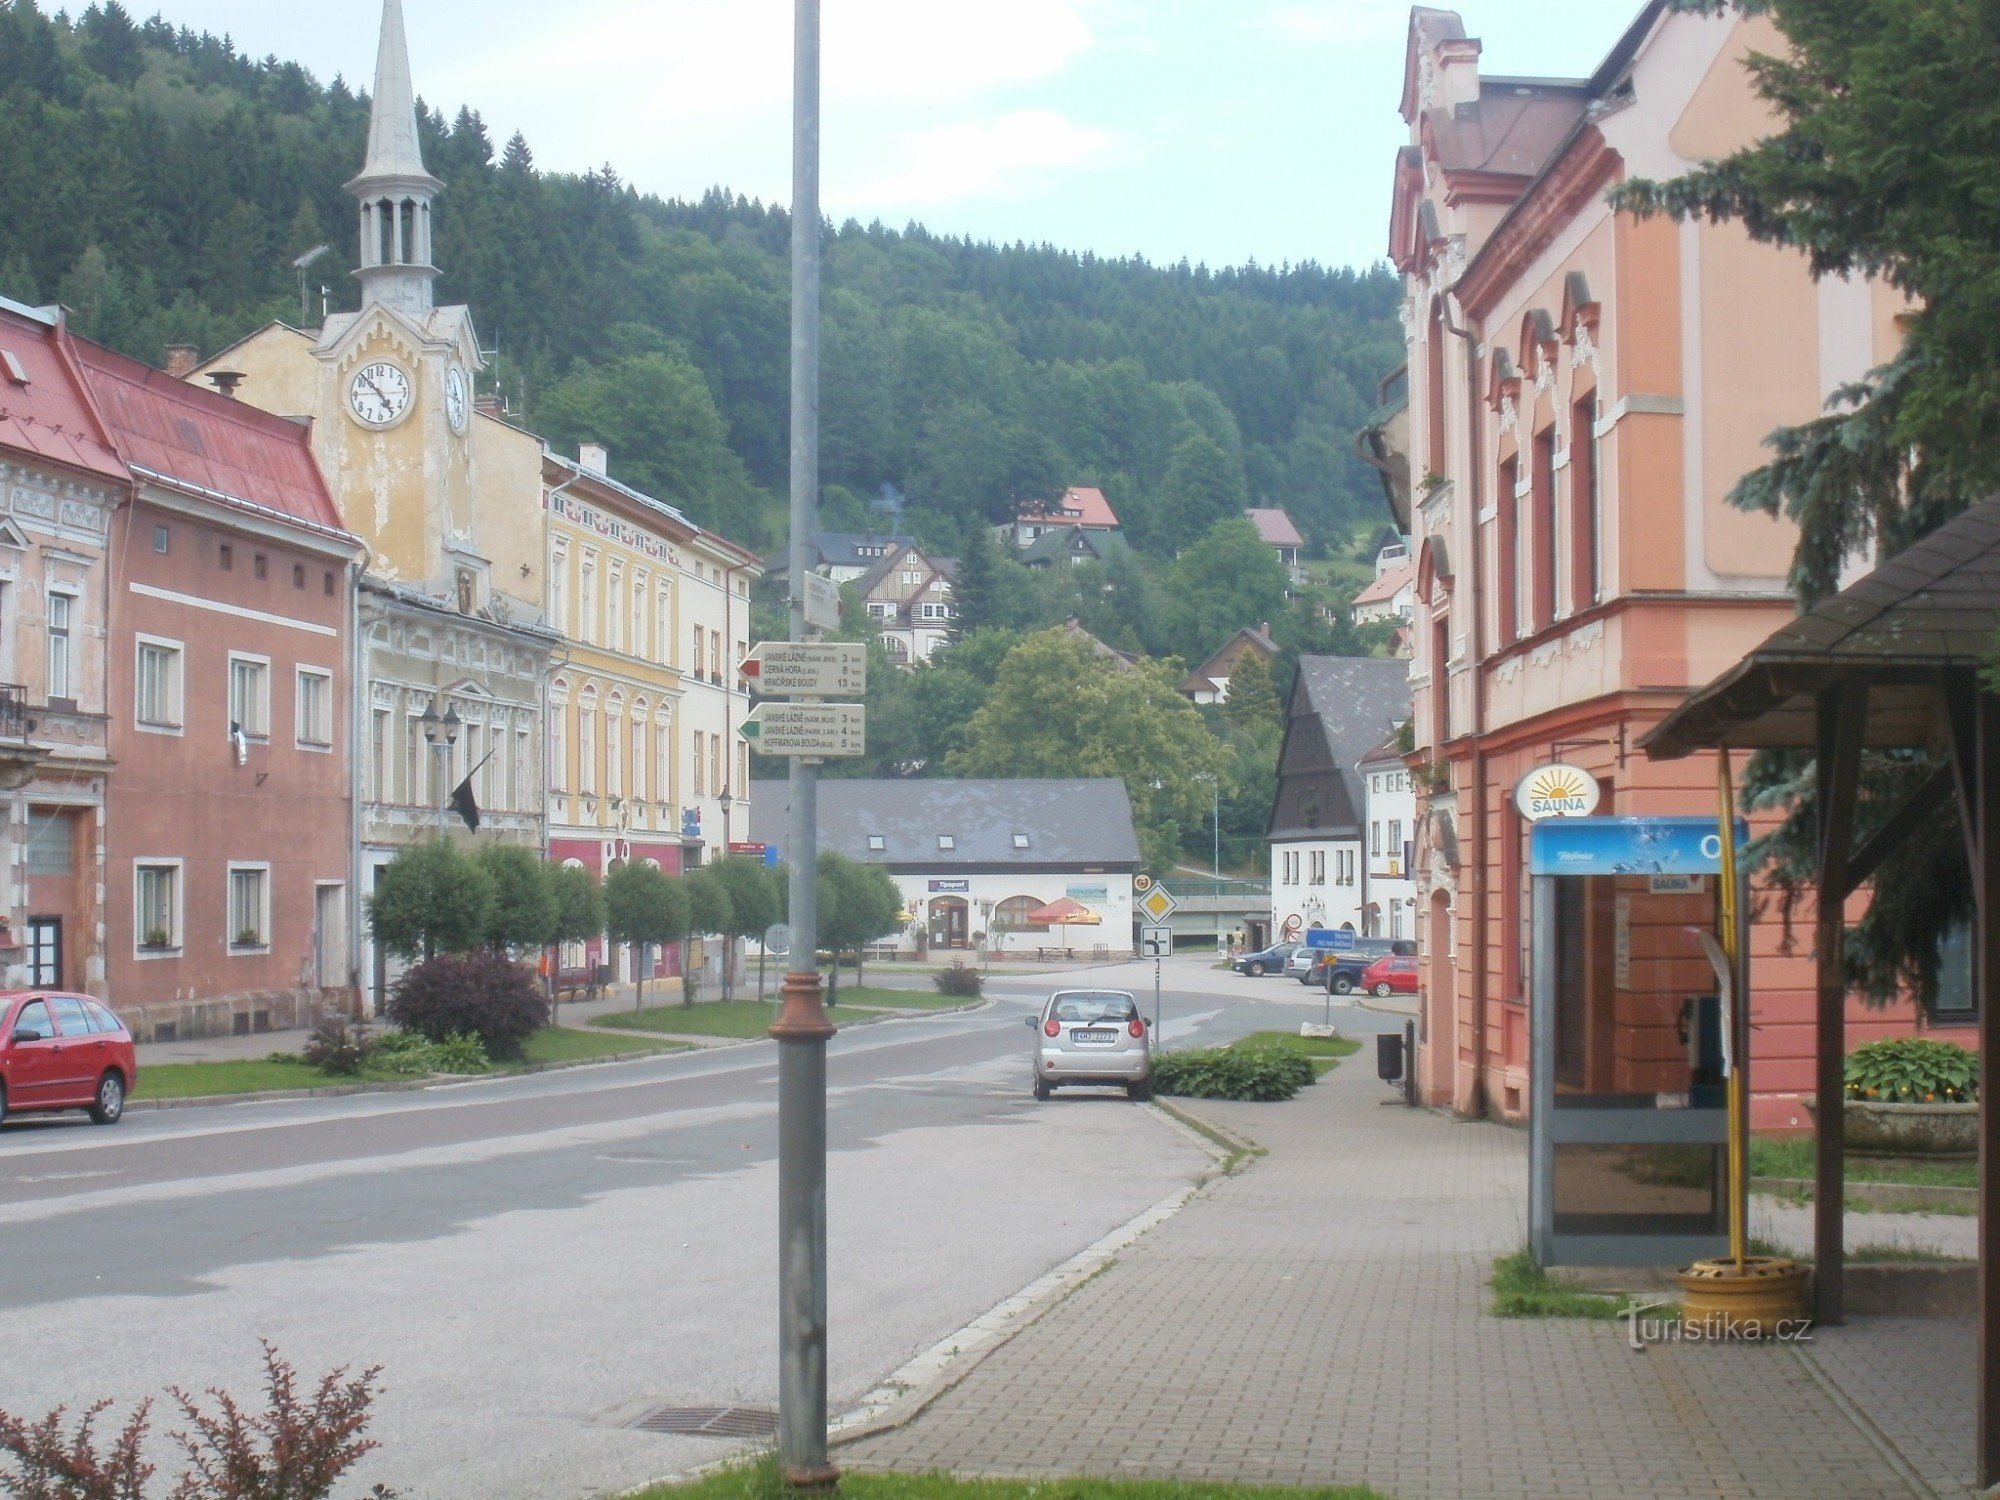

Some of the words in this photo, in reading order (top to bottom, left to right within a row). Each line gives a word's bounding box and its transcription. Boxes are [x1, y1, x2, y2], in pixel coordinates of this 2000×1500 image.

[367, 368, 374, 380] 11
[376, 365, 384, 376] 12
[390, 368, 393, 378] 1
[358, 377, 366, 388] 10
[397, 374, 403, 386] 2
[353, 390, 358, 401] 9
[402, 387, 407, 398] 3
[358, 400, 364, 412] 8
[397, 400, 402, 410] 4
[367, 408, 373, 420] 7
[378, 413, 384, 421] 6
[389, 406, 394, 418] 5
[842, 654, 848, 662] 3
[764, 664, 784, 674] ČERNÁ
[784, 666, 801, 674] HORA
[798, 678, 818, 688] BOUDY
[838, 679, 848, 688] 13
[842, 714, 848, 723] 3
[841, 726, 848, 736] 4
[801, 738, 820, 748] BOUDA
[841, 738, 848, 748] 5
[1532, 797, 1586, 813] SAUNA
[1700, 834, 1722, 859] O
[1652, 878, 1689, 890] SAUNA
